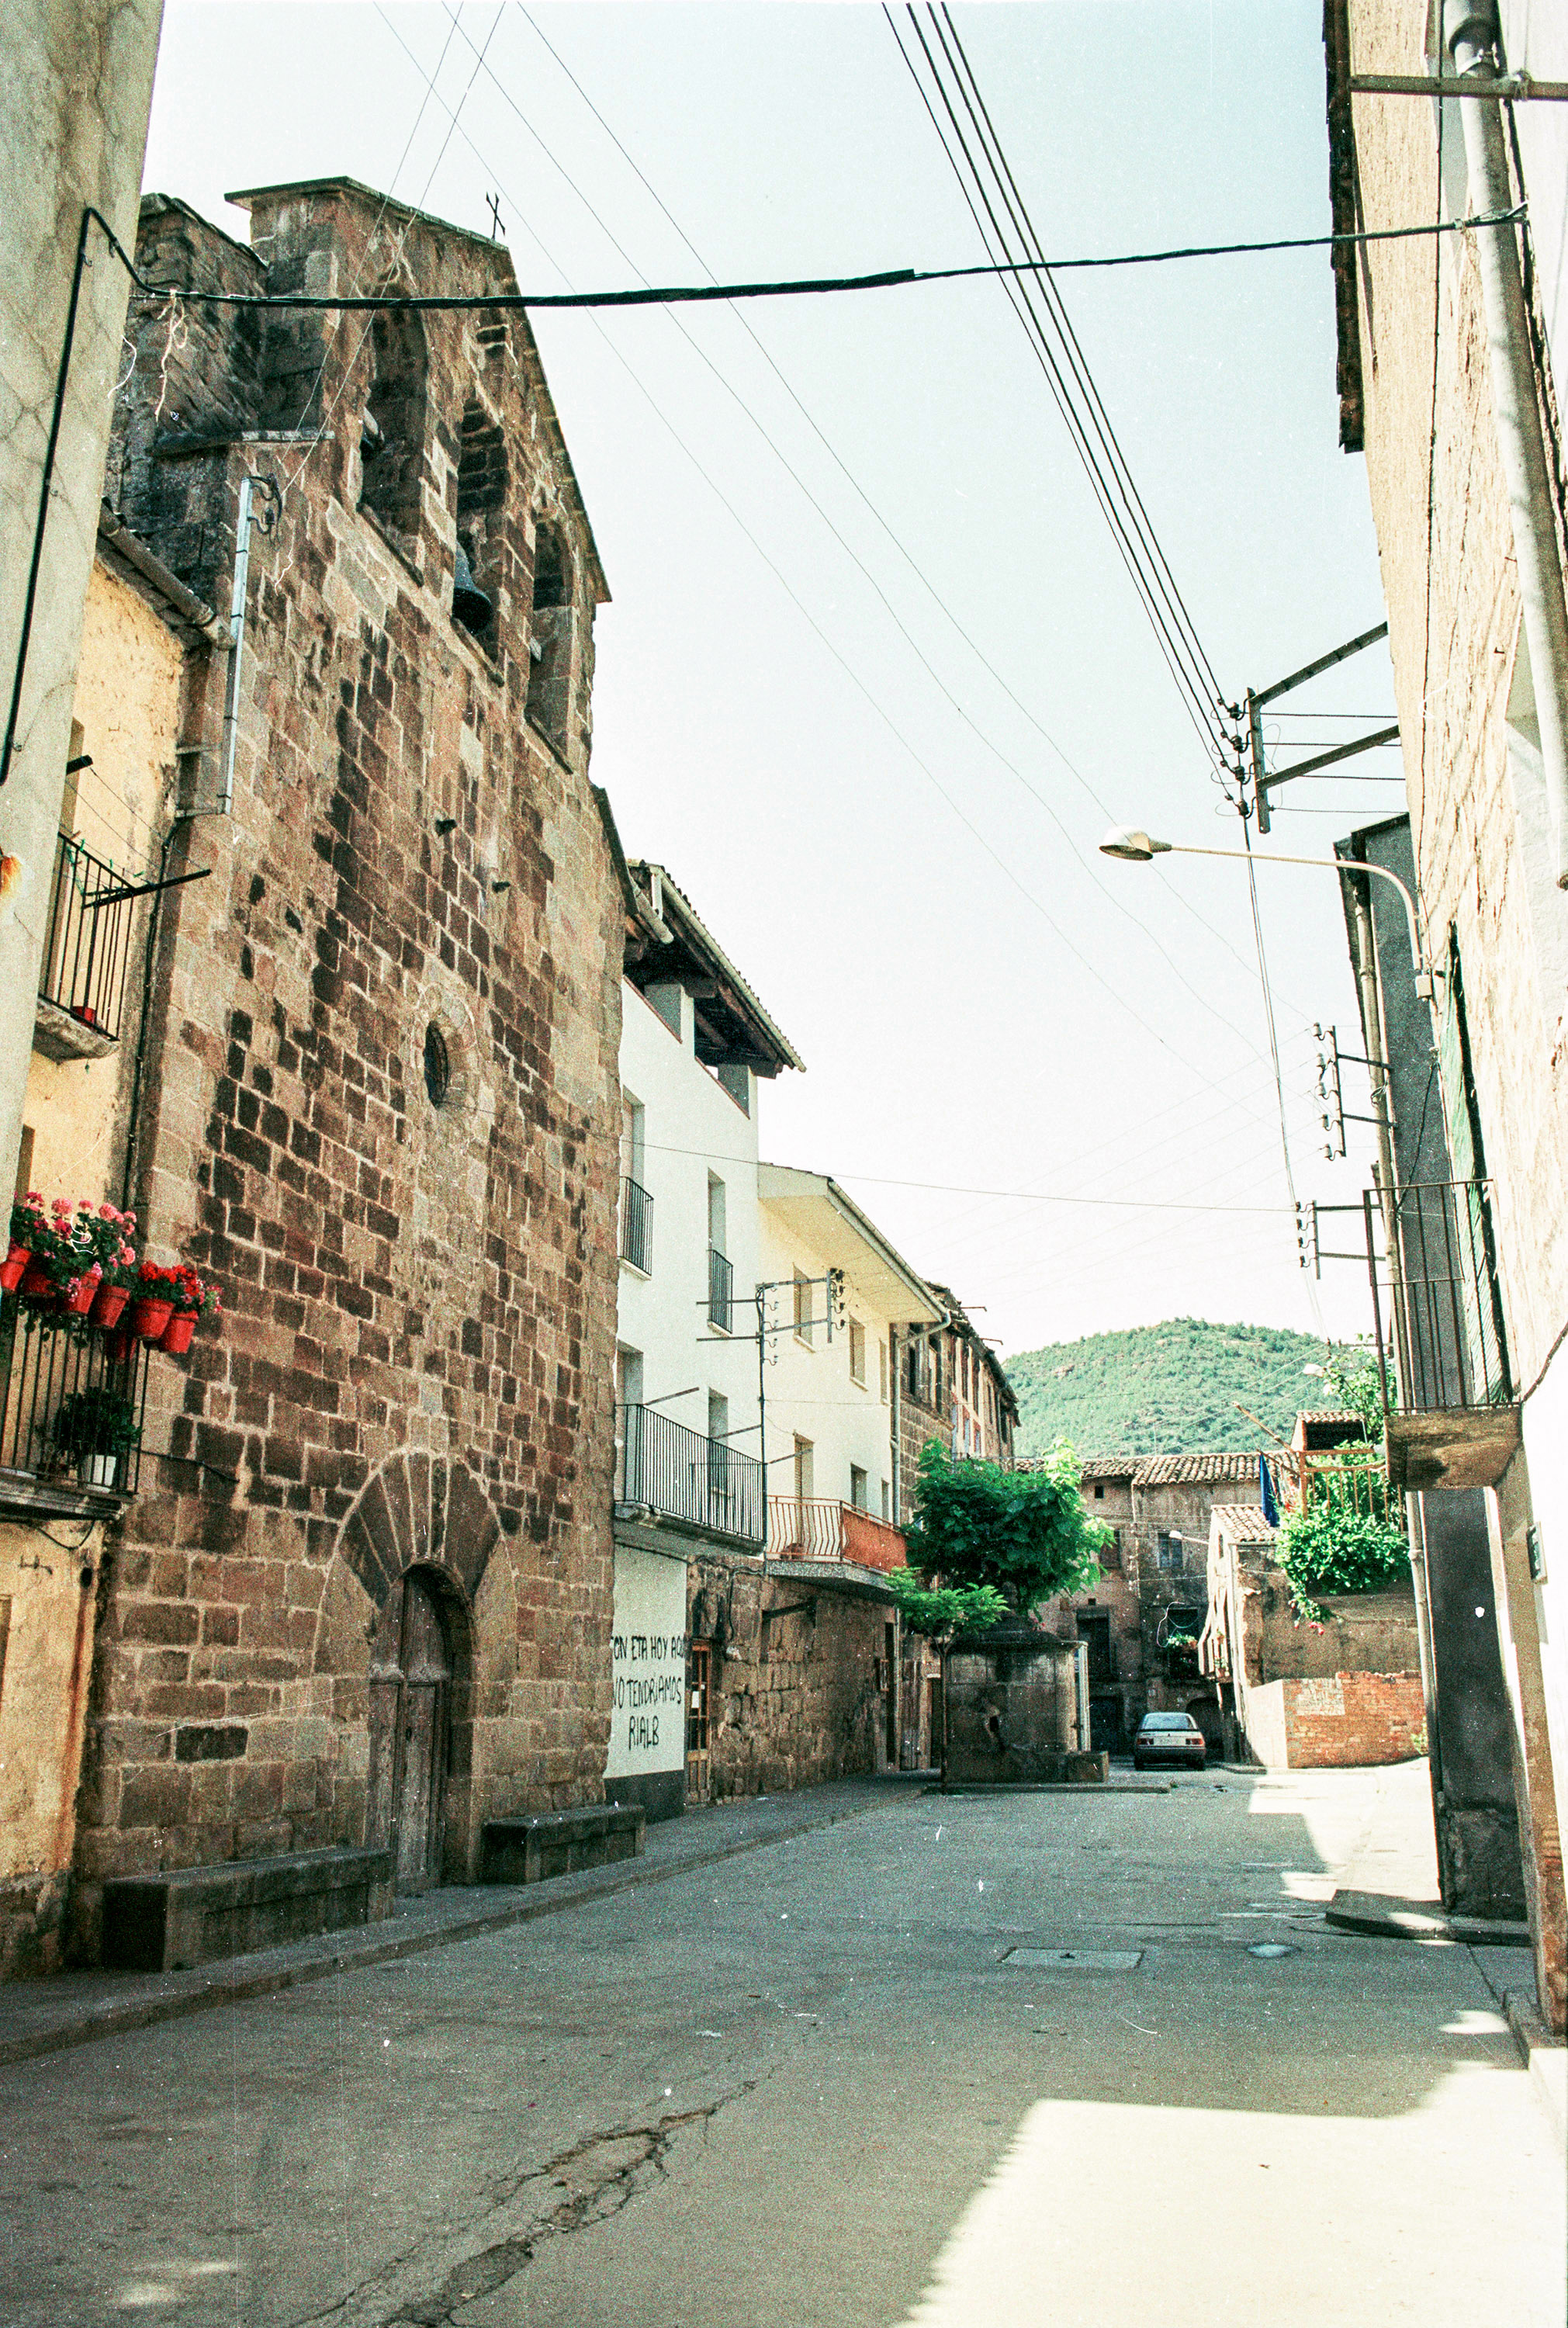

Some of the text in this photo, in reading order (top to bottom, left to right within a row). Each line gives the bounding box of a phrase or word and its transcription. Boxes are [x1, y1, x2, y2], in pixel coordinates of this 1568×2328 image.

[611, 1635, 628, 1660] ON
[631, 1635, 648, 1661] ETA
[650, 1636, 669, 1660] HOY
[628, 1715, 659, 1751] RIALB
